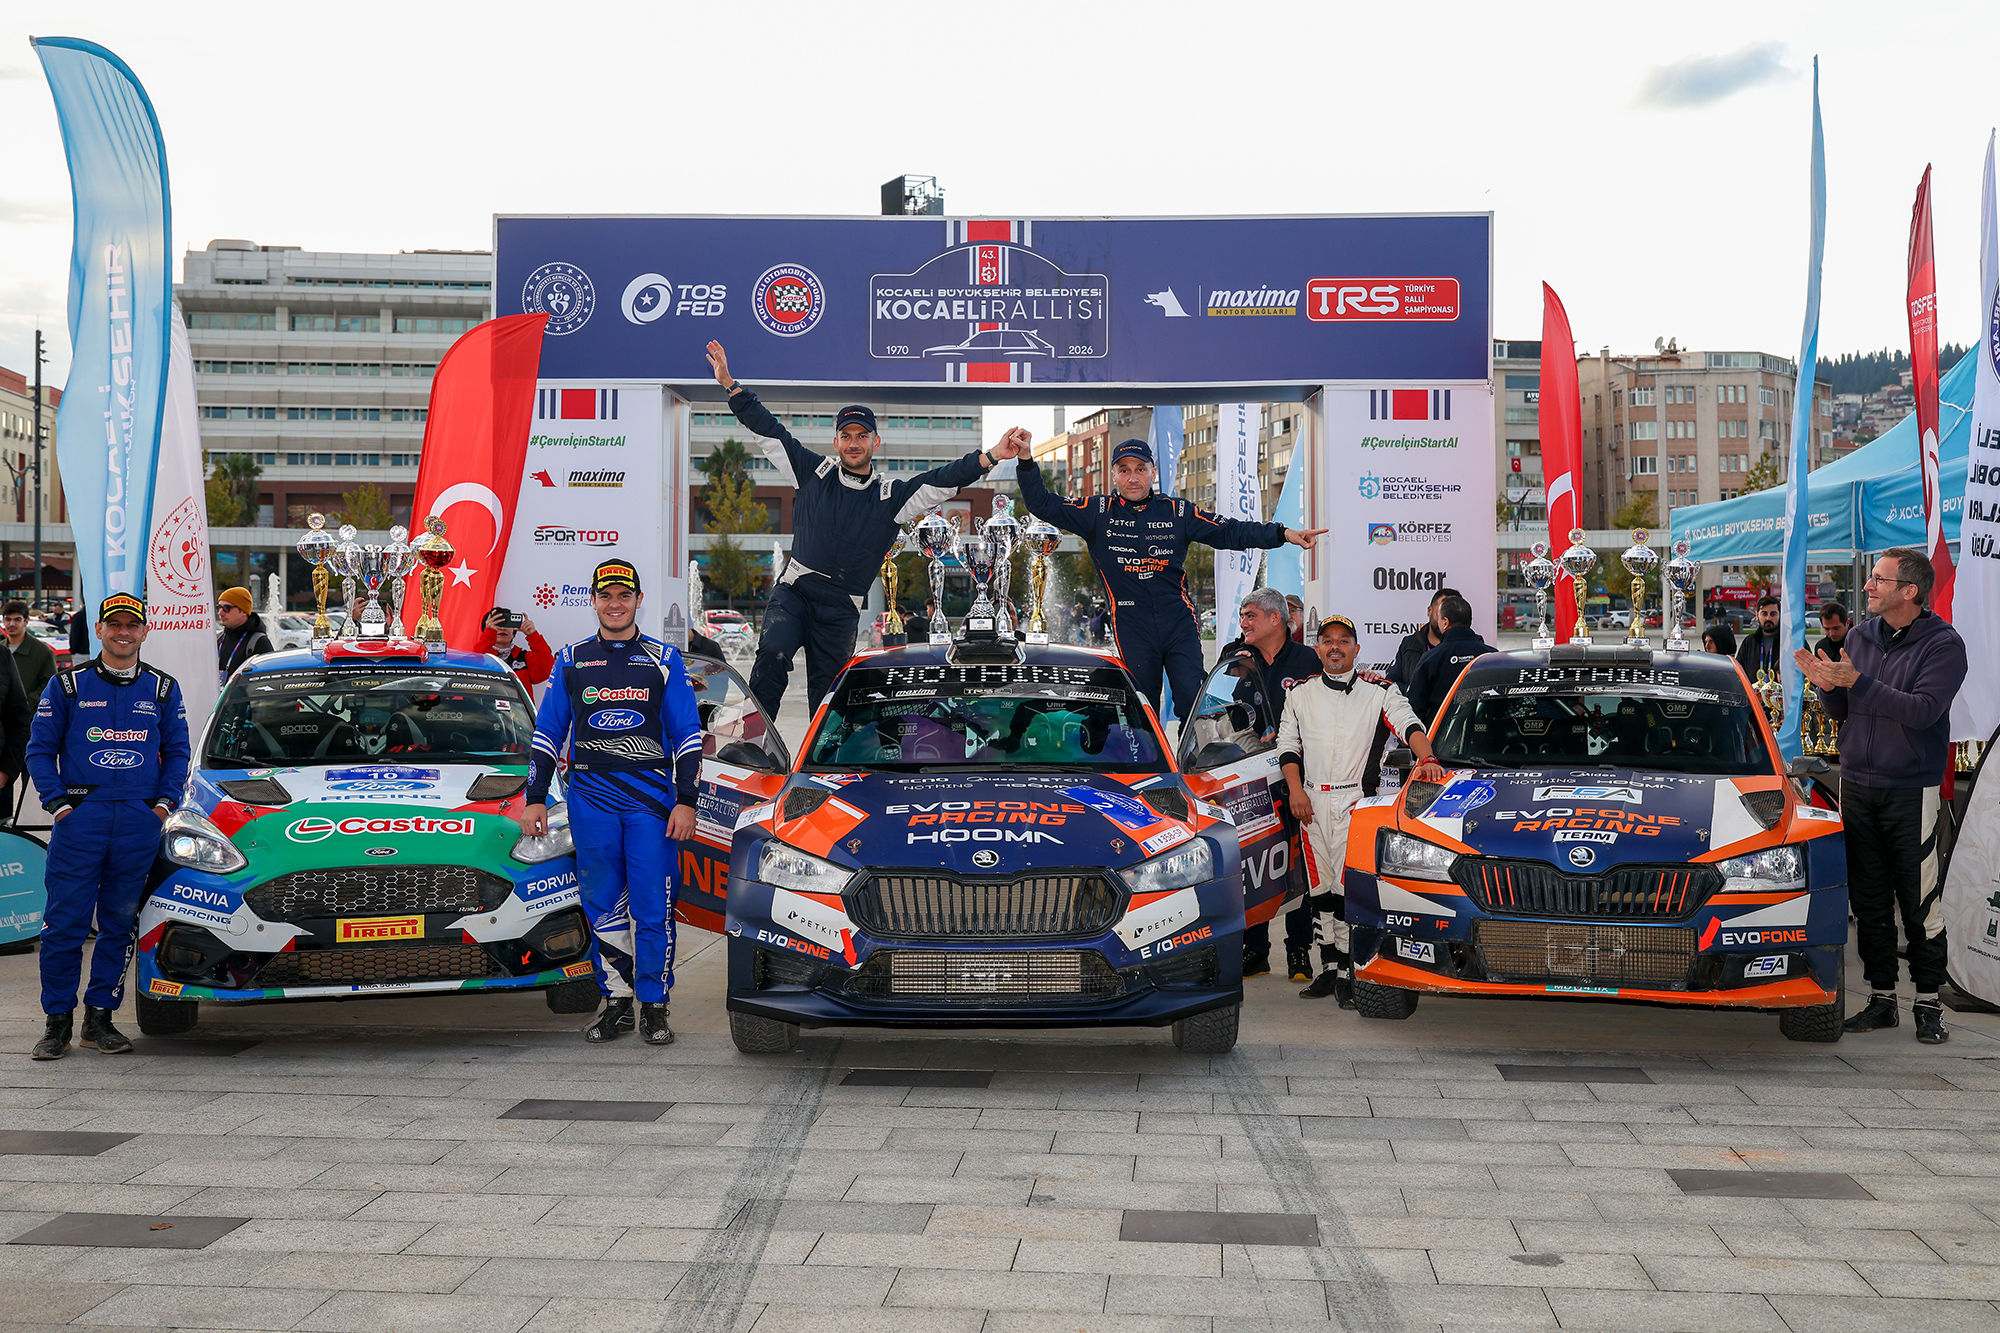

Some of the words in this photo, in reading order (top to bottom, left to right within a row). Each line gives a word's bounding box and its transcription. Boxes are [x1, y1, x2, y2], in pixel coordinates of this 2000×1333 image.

[981, 250, 996, 259] 43.
[678, 284, 726, 300] TOS
[756, 283, 769, 320] KOCAELI
[764, 268, 807, 284] OTOMOBIL
[806, 277, 821, 322] SPORLARI
[876, 288, 933, 297] KOCAELİ
[938, 288, 1022, 298] BÜYÜKŞEHİR
[1026, 288, 1102, 297] BELEDİYESİ
[1404, 284, 1435, 293] TÜRKİYE
[1207, 284, 1300, 308] maxima
[1312, 286, 1400, 315] TRS
[1404, 294, 1424, 303] RALLİ
[676, 301, 725, 316] FED
[1404, 305, 1454, 314] ŞAMPİYONASI
[770, 321, 807, 332] KULÜBÜ
[886, 345, 909, 355] 1970
[1068, 345, 1093, 355] 2026
[568, 468, 626, 482] maxima
[1382, 484, 1462, 492] BÜYÜKŞEHİR
[1898, 506, 1926, 520] KOCA
[1109, 518, 1136, 527] PETKIT
[1398, 521, 1452, 534] KÖRFEZ
[1692, 524, 1724, 540] KOCAELİ
[1724, 517, 1774, 536] BÜYÜKŞEHİR
[1398, 534, 1452, 542] BELEDİYESİ
[1116, 556, 1170, 566] EVOFONE
[1124, 564, 1164, 573] RACING
[1373, 567, 1446, 590] Otokar
[1364, 623, 1426, 634] TELSAN
[249, 672, 325, 682] CASTROL
[886, 666, 1091, 684] NOTHING
[1520, 668, 1680, 685] NOTHING
[599, 686, 650, 702] Castrol
[895, 688, 938, 697] maxima
[1068, 690, 1110, 700] maxima
[1508, 686, 1549, 694] maxima
[1676, 690, 1720, 700] maxima
[1666, 704, 1688, 712] OMP
[598, 712, 634, 727] Ford
[1524, 721, 1544, 730] OMP
[103, 729, 148, 742] Castrol
[898, 725, 918, 734] OMP
[100, 750, 136, 766] Ford
[368, 772, 398, 780] 10
[884, 776, 949, 784] TECNO
[347, 780, 415, 790] Ford
[904, 782, 973, 790] NOTHING
[886, 800, 1086, 815] EVOFONE
[1090, 802, 1114, 810] 2
[908, 811, 1068, 826] RACING
[1495, 808, 1681, 826] EVOFONE
[337, 816, 475, 836] Castrol
[1512, 818, 1662, 836] RACING
[1560, 832, 1612, 840] TEAM
[526, 871, 577, 895] FORVIA
[172, 884, 230, 908] FORVIA
[526, 895, 561, 912] FORD
[150, 900, 176, 912] FORD
[177, 906, 231, 925] RACING
[343, 919, 419, 938] PIRELLI
[800, 917, 840, 938] PETKIT
[756, 929, 831, 960] EVOFONE
[1722, 929, 1808, 946] EVOFONE
[1400, 940, 1432, 958] FGA
[568, 963, 592, 977] PIRELLI
[1748, 958, 1784, 975] FGA
[152, 979, 180, 995] PIRELLI
